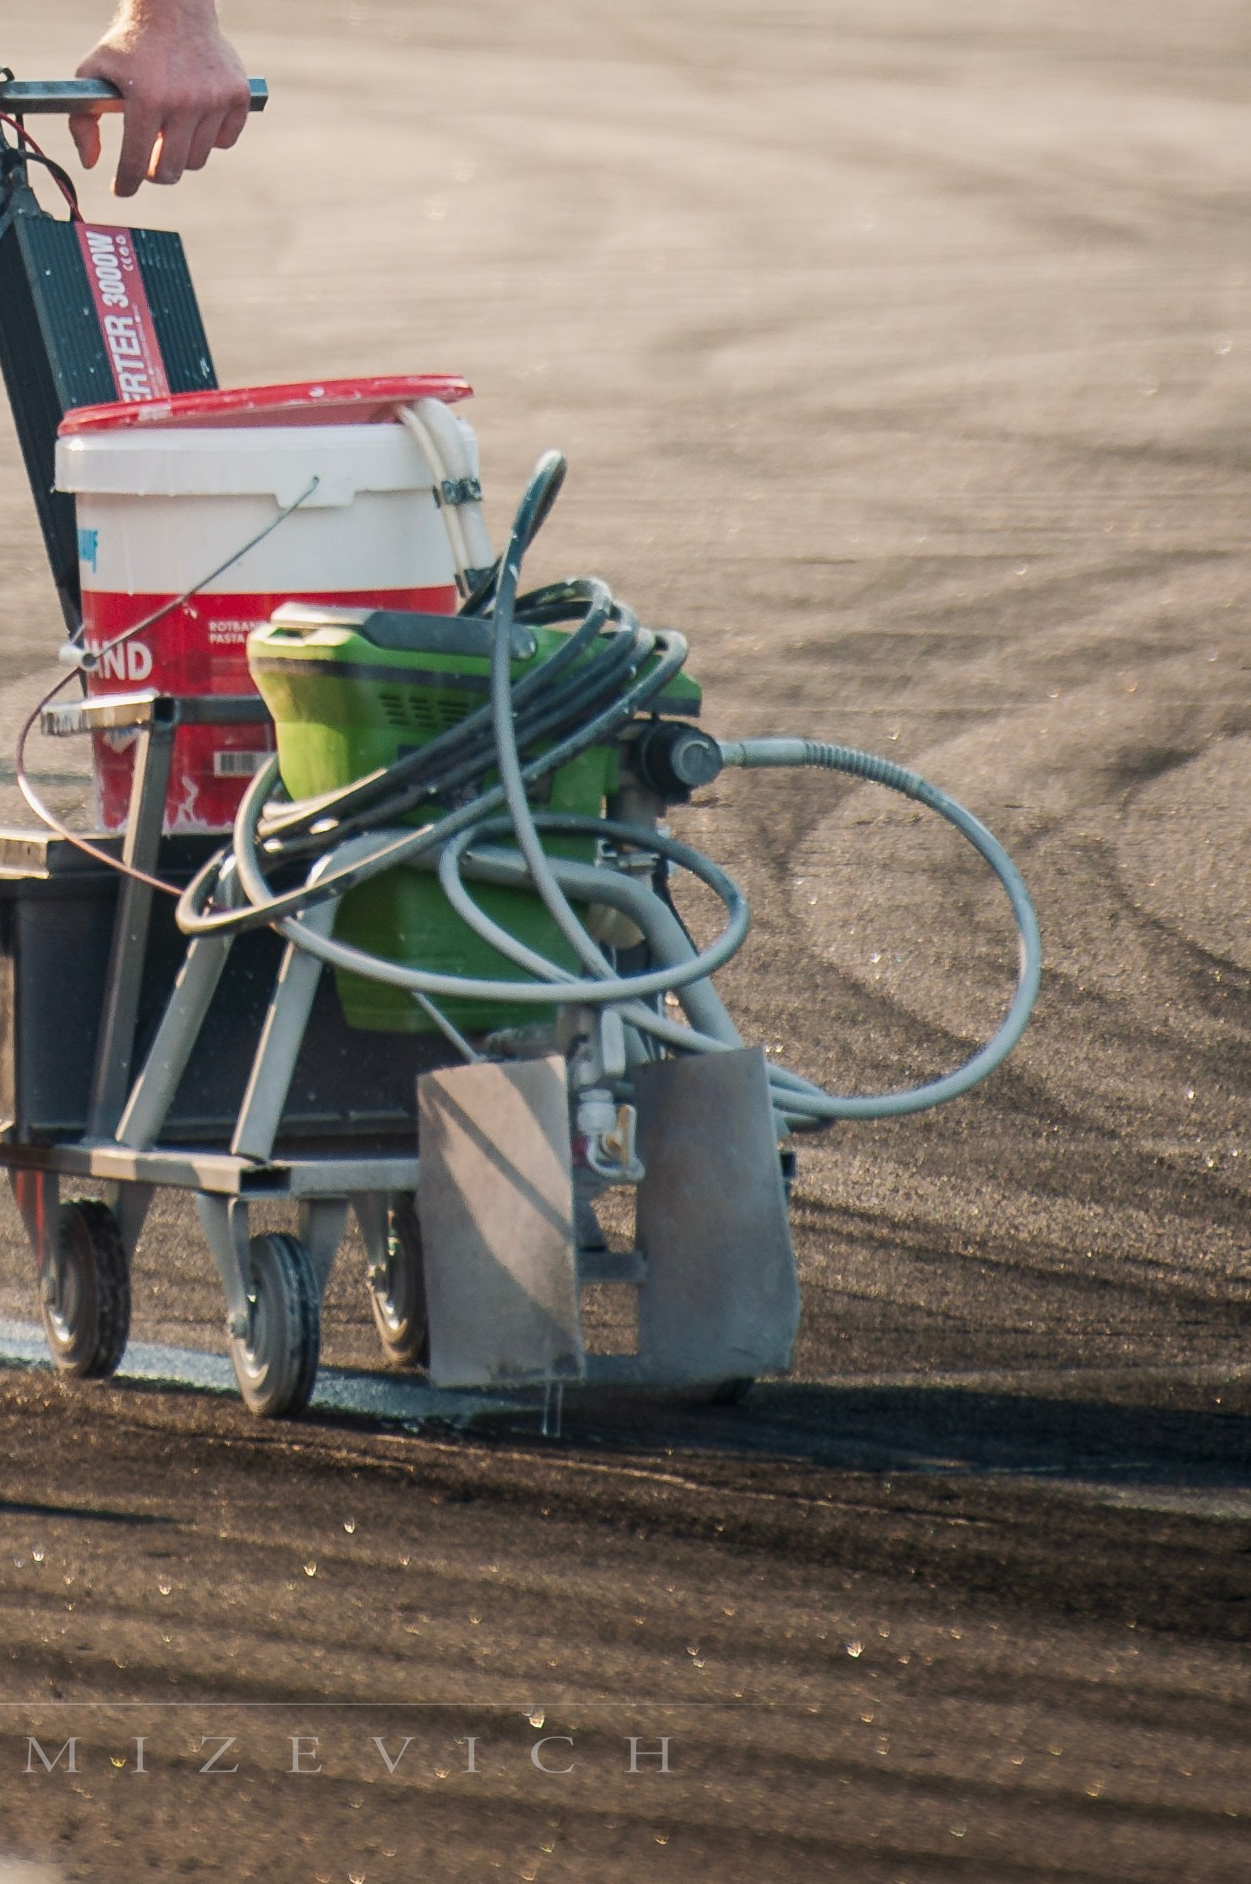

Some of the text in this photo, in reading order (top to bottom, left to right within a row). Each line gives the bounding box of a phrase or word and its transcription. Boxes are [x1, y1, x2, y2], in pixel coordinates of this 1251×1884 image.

[85, 231, 129, 309] 3000W
[209, 620, 267, 633] ROTBAN
[210, 632, 245, 644] PASTA
